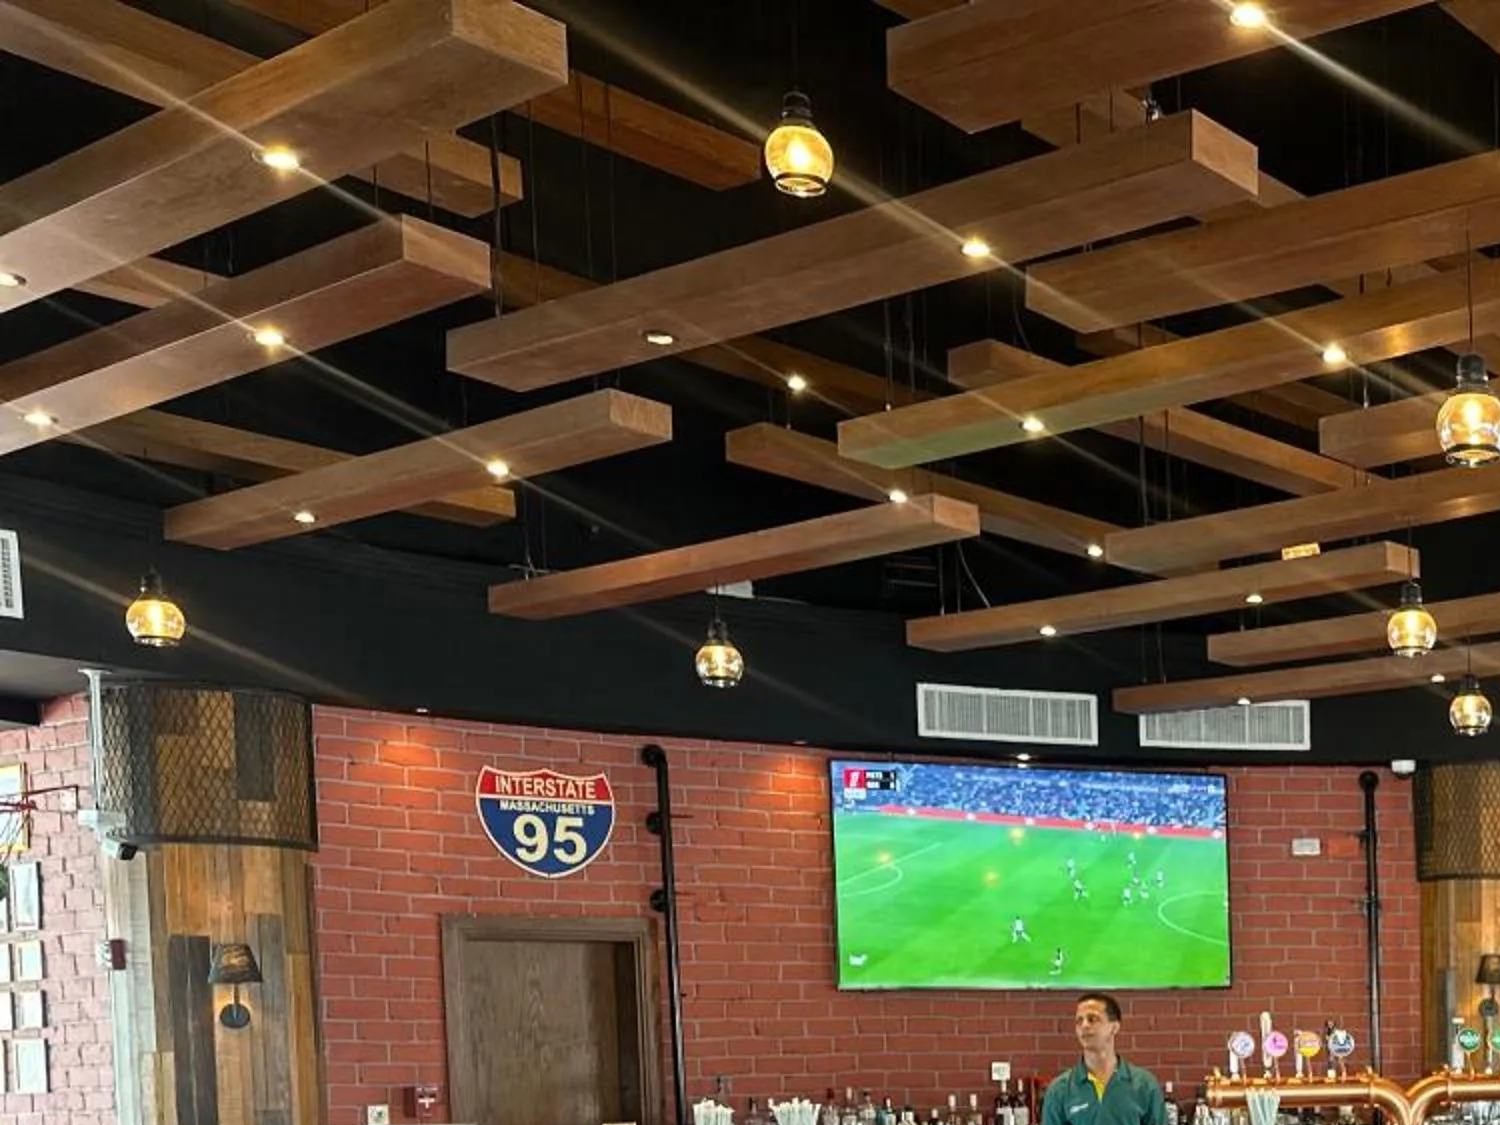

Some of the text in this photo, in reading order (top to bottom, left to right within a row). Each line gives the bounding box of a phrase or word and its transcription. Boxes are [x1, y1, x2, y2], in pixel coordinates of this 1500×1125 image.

[495, 775, 597, 799] INTERSTATE
[499, 801, 596, 816] MASSACHUSETTS
[513, 814, 587, 865] 95
